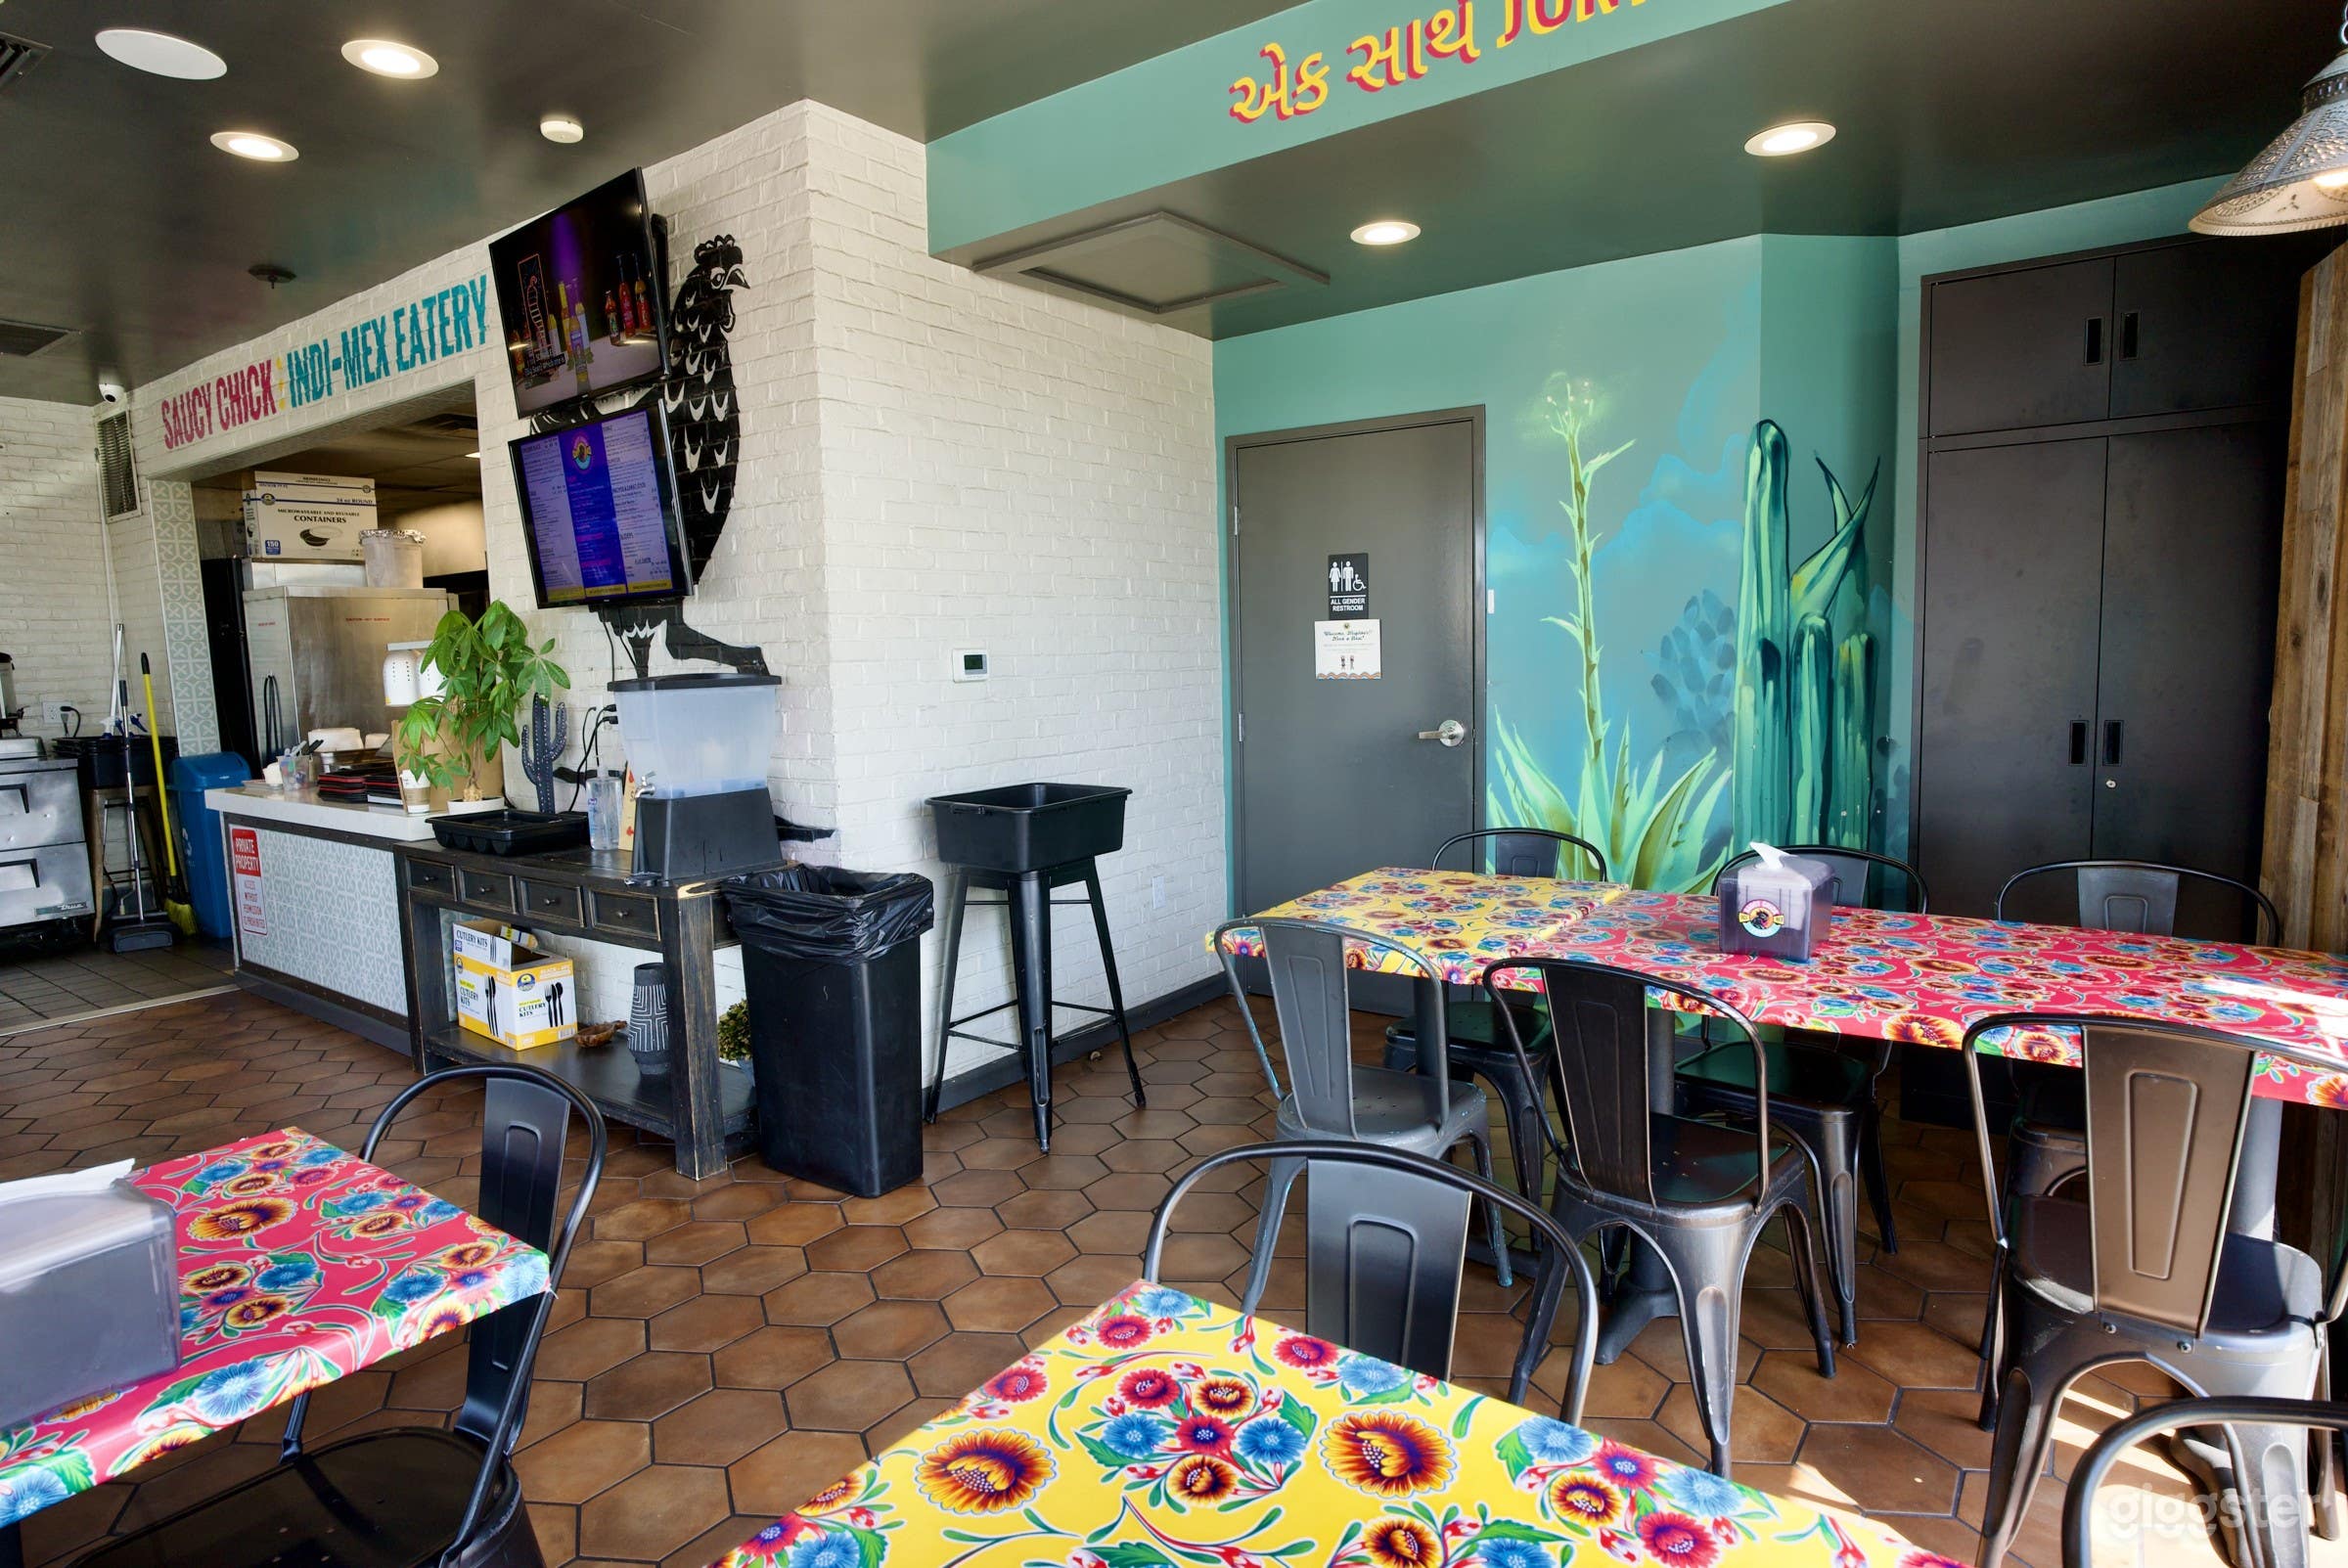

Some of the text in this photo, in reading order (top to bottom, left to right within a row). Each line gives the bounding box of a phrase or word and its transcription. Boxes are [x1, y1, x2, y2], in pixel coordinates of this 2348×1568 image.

[1229, 42, 1331, 123] એક
[161, 274, 487, 450] SAUCY CHICK INDI-MEX EATERY
[294, 515, 346, 523] CONTAINERS
[235, 837, 255, 854] PRIVATE
[235, 854, 259, 872] PROPERTY
[456, 929, 476, 944] CUTLERY
[476, 936, 487, 948] KITS
[460, 986, 478, 1002] CUTLERY
[460, 996, 471, 1007] KITS
[519, 1003, 546, 1012] CUTLERY
